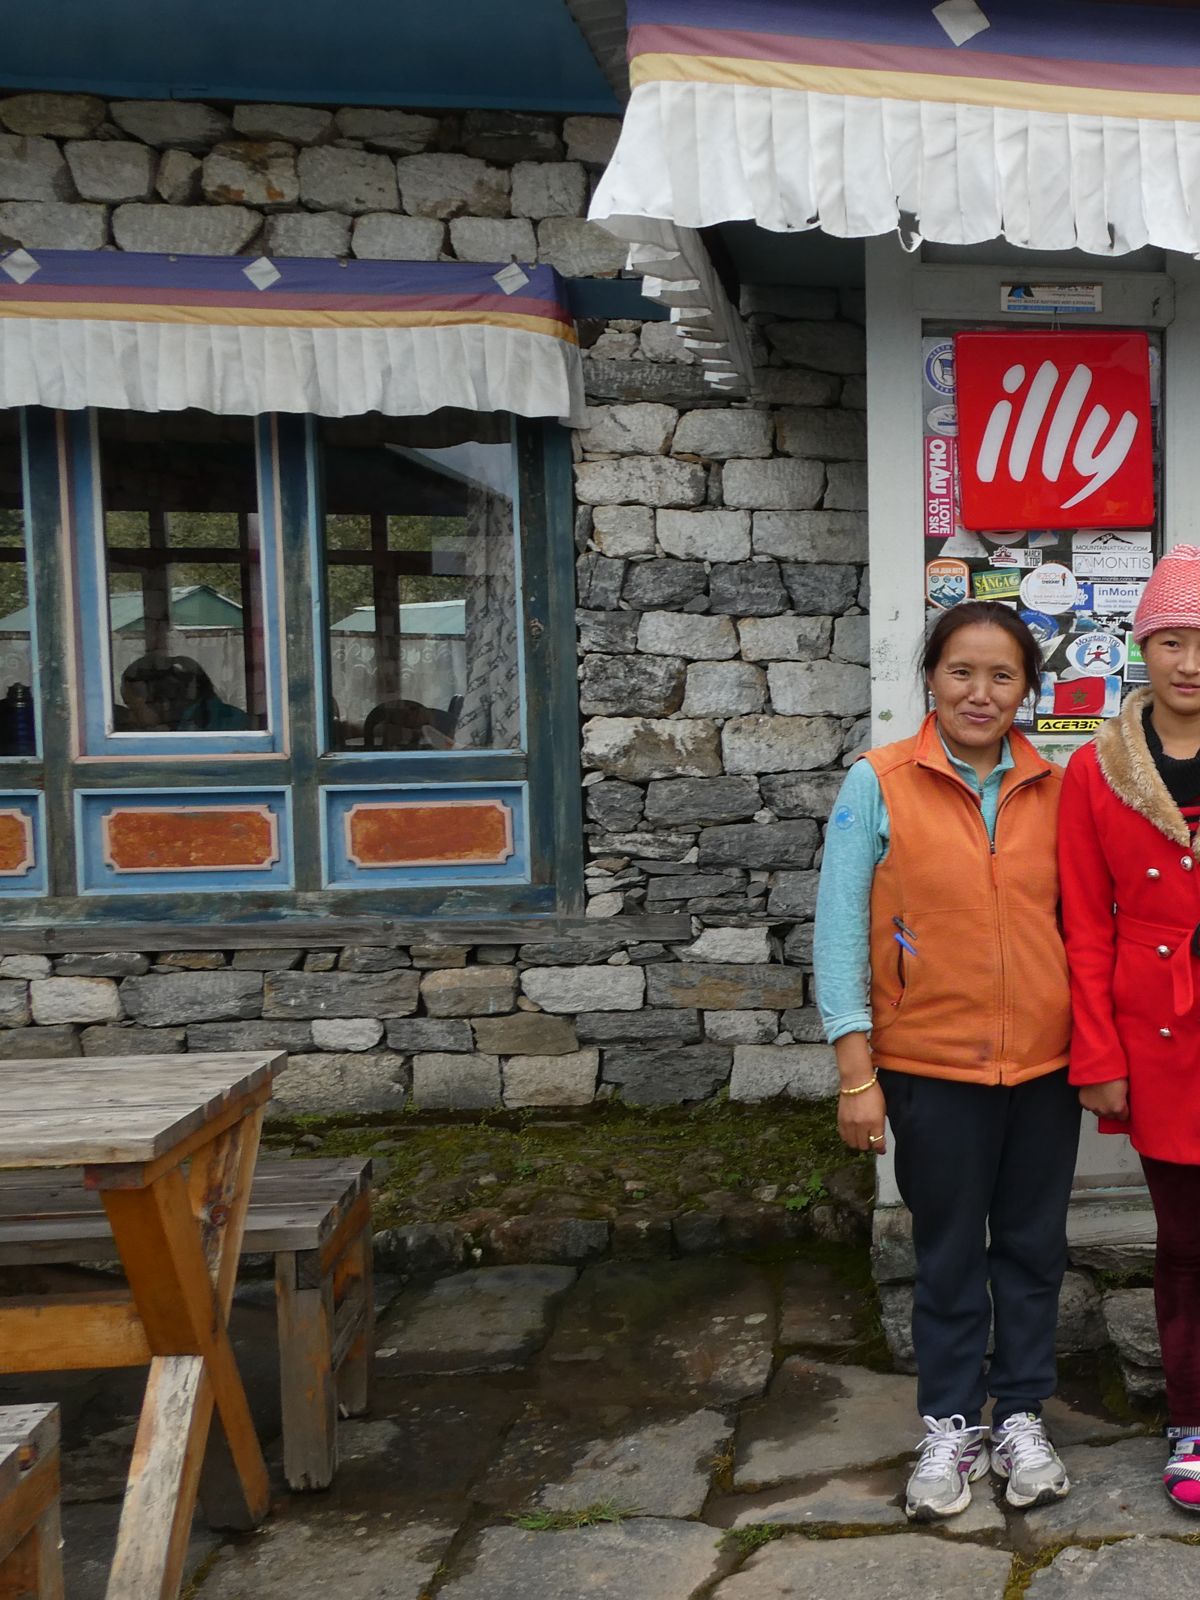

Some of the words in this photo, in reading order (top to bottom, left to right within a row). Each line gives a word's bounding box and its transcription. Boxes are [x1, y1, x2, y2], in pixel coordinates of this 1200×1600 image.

[976, 359, 1139, 509] illy
[929, 498, 939, 514] TO
[929, 515, 939, 534] SKI
[939, 504, 950, 534] LOVE
[1093, 556, 1151, 570] MONTIS
[1098, 588, 1138, 596] inMont
[1075, 635, 1108, 648] Mountain
